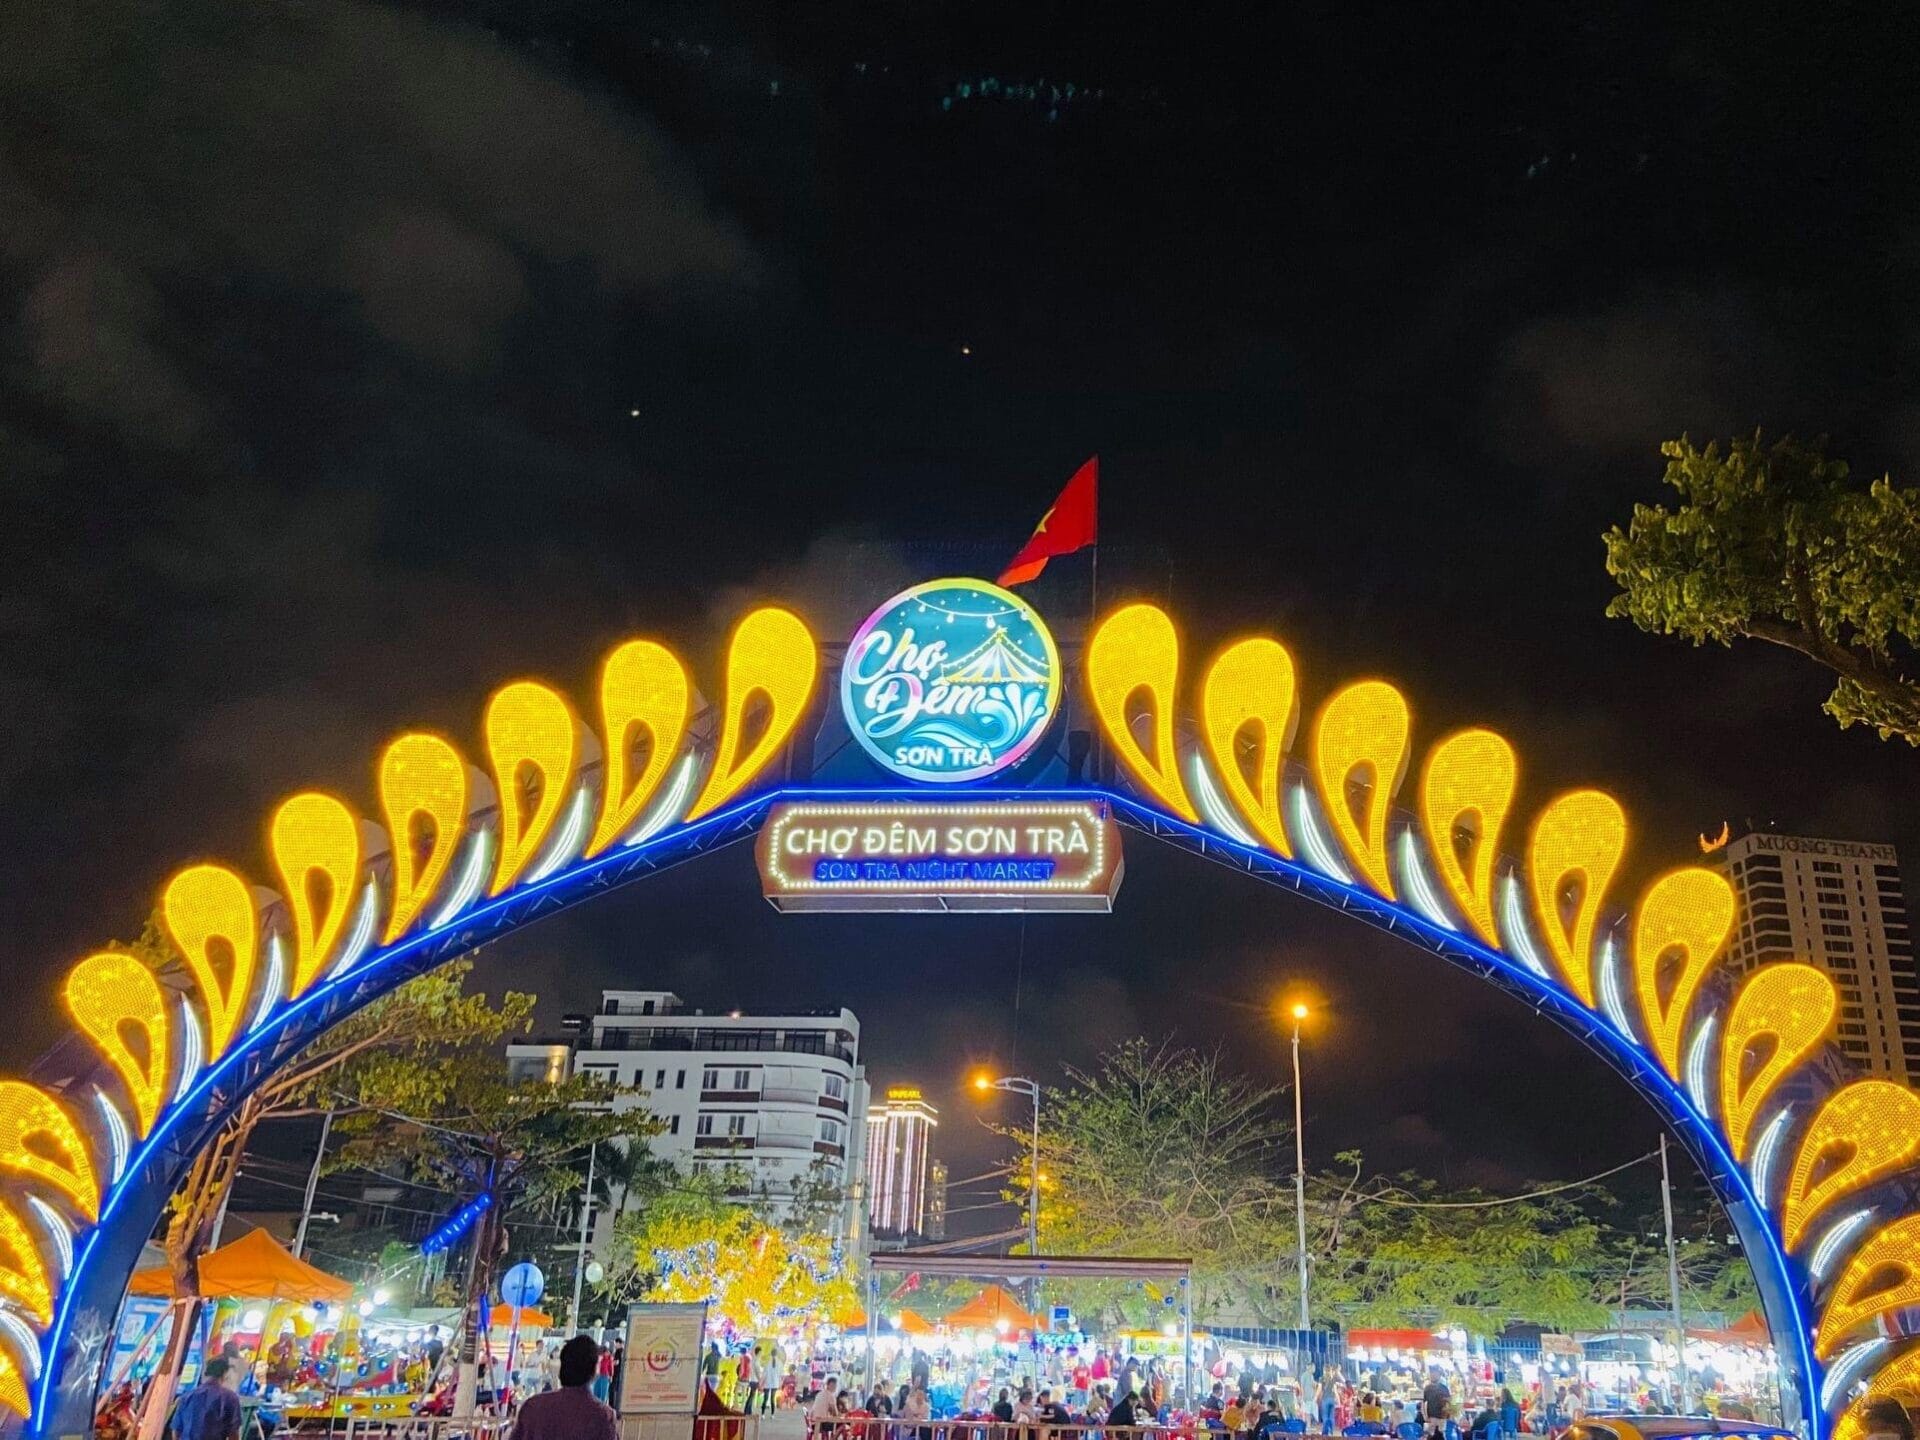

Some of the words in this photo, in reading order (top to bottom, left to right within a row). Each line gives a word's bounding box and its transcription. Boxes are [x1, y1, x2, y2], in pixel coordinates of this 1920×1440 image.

[849, 628, 948, 685] Chợ
[895, 745, 943, 766] SƠN
[949, 742, 994, 766] TRÀ
[786, 826, 859, 859] CHỢ
[863, 821, 937, 854] ĐÊM
[946, 827, 1017, 854] SƠN
[1026, 820, 1090, 854] TRÀ
[817, 862, 858, 879] SON
[864, 862, 901, 879] TRA
[907, 862, 969, 879] NIGHT
[974, 862, 1055, 879] MARKET
